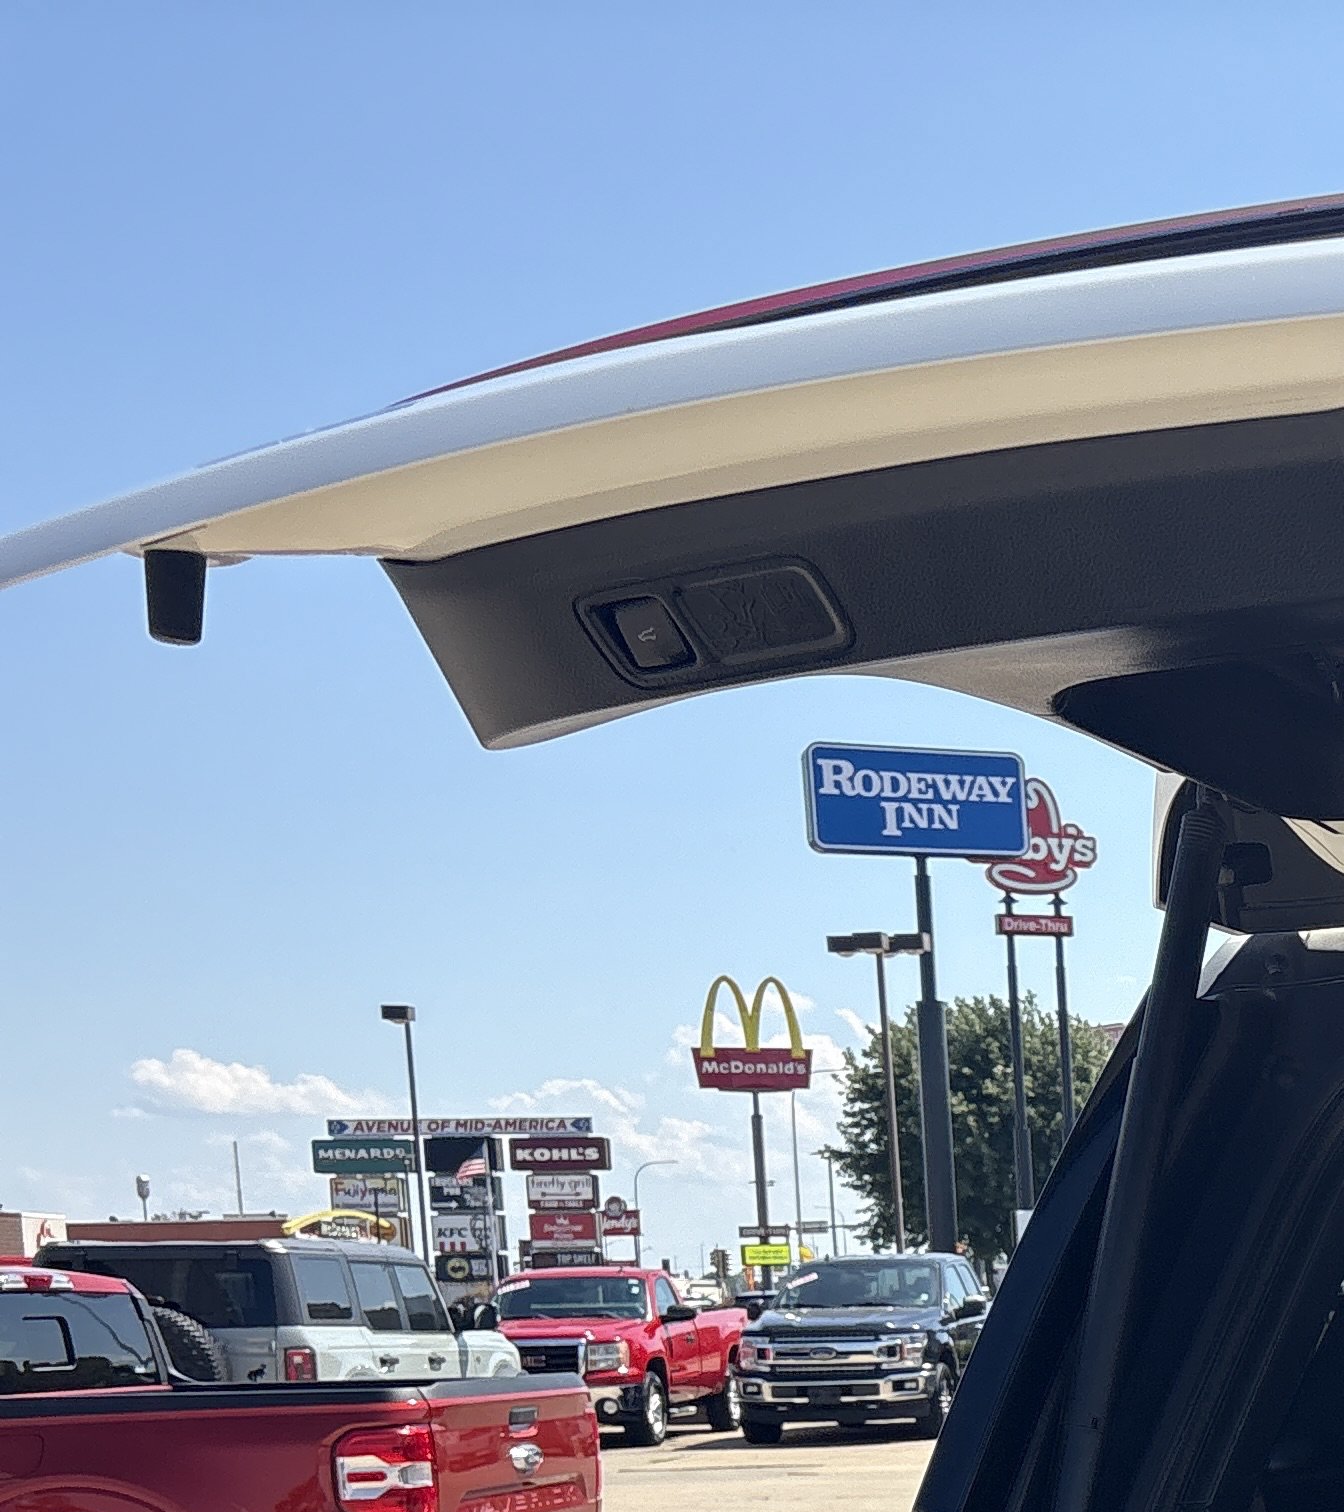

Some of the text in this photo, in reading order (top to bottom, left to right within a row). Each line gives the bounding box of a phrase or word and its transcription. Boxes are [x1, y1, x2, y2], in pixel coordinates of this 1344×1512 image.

[816, 758, 1016, 803] RODEWAY
[881, 801, 960, 837] INN
[1020, 825, 1095, 871] by's
[1004, 918, 1068, 933] Drive-Thru
[701, 1060, 807, 1074] McDonald's
[353, 1118, 567, 1133] AVENU OF MID-AMERICA
[515, 1147, 600, 1161] KOHL'S
[437, 1227, 468, 1238] KFC
